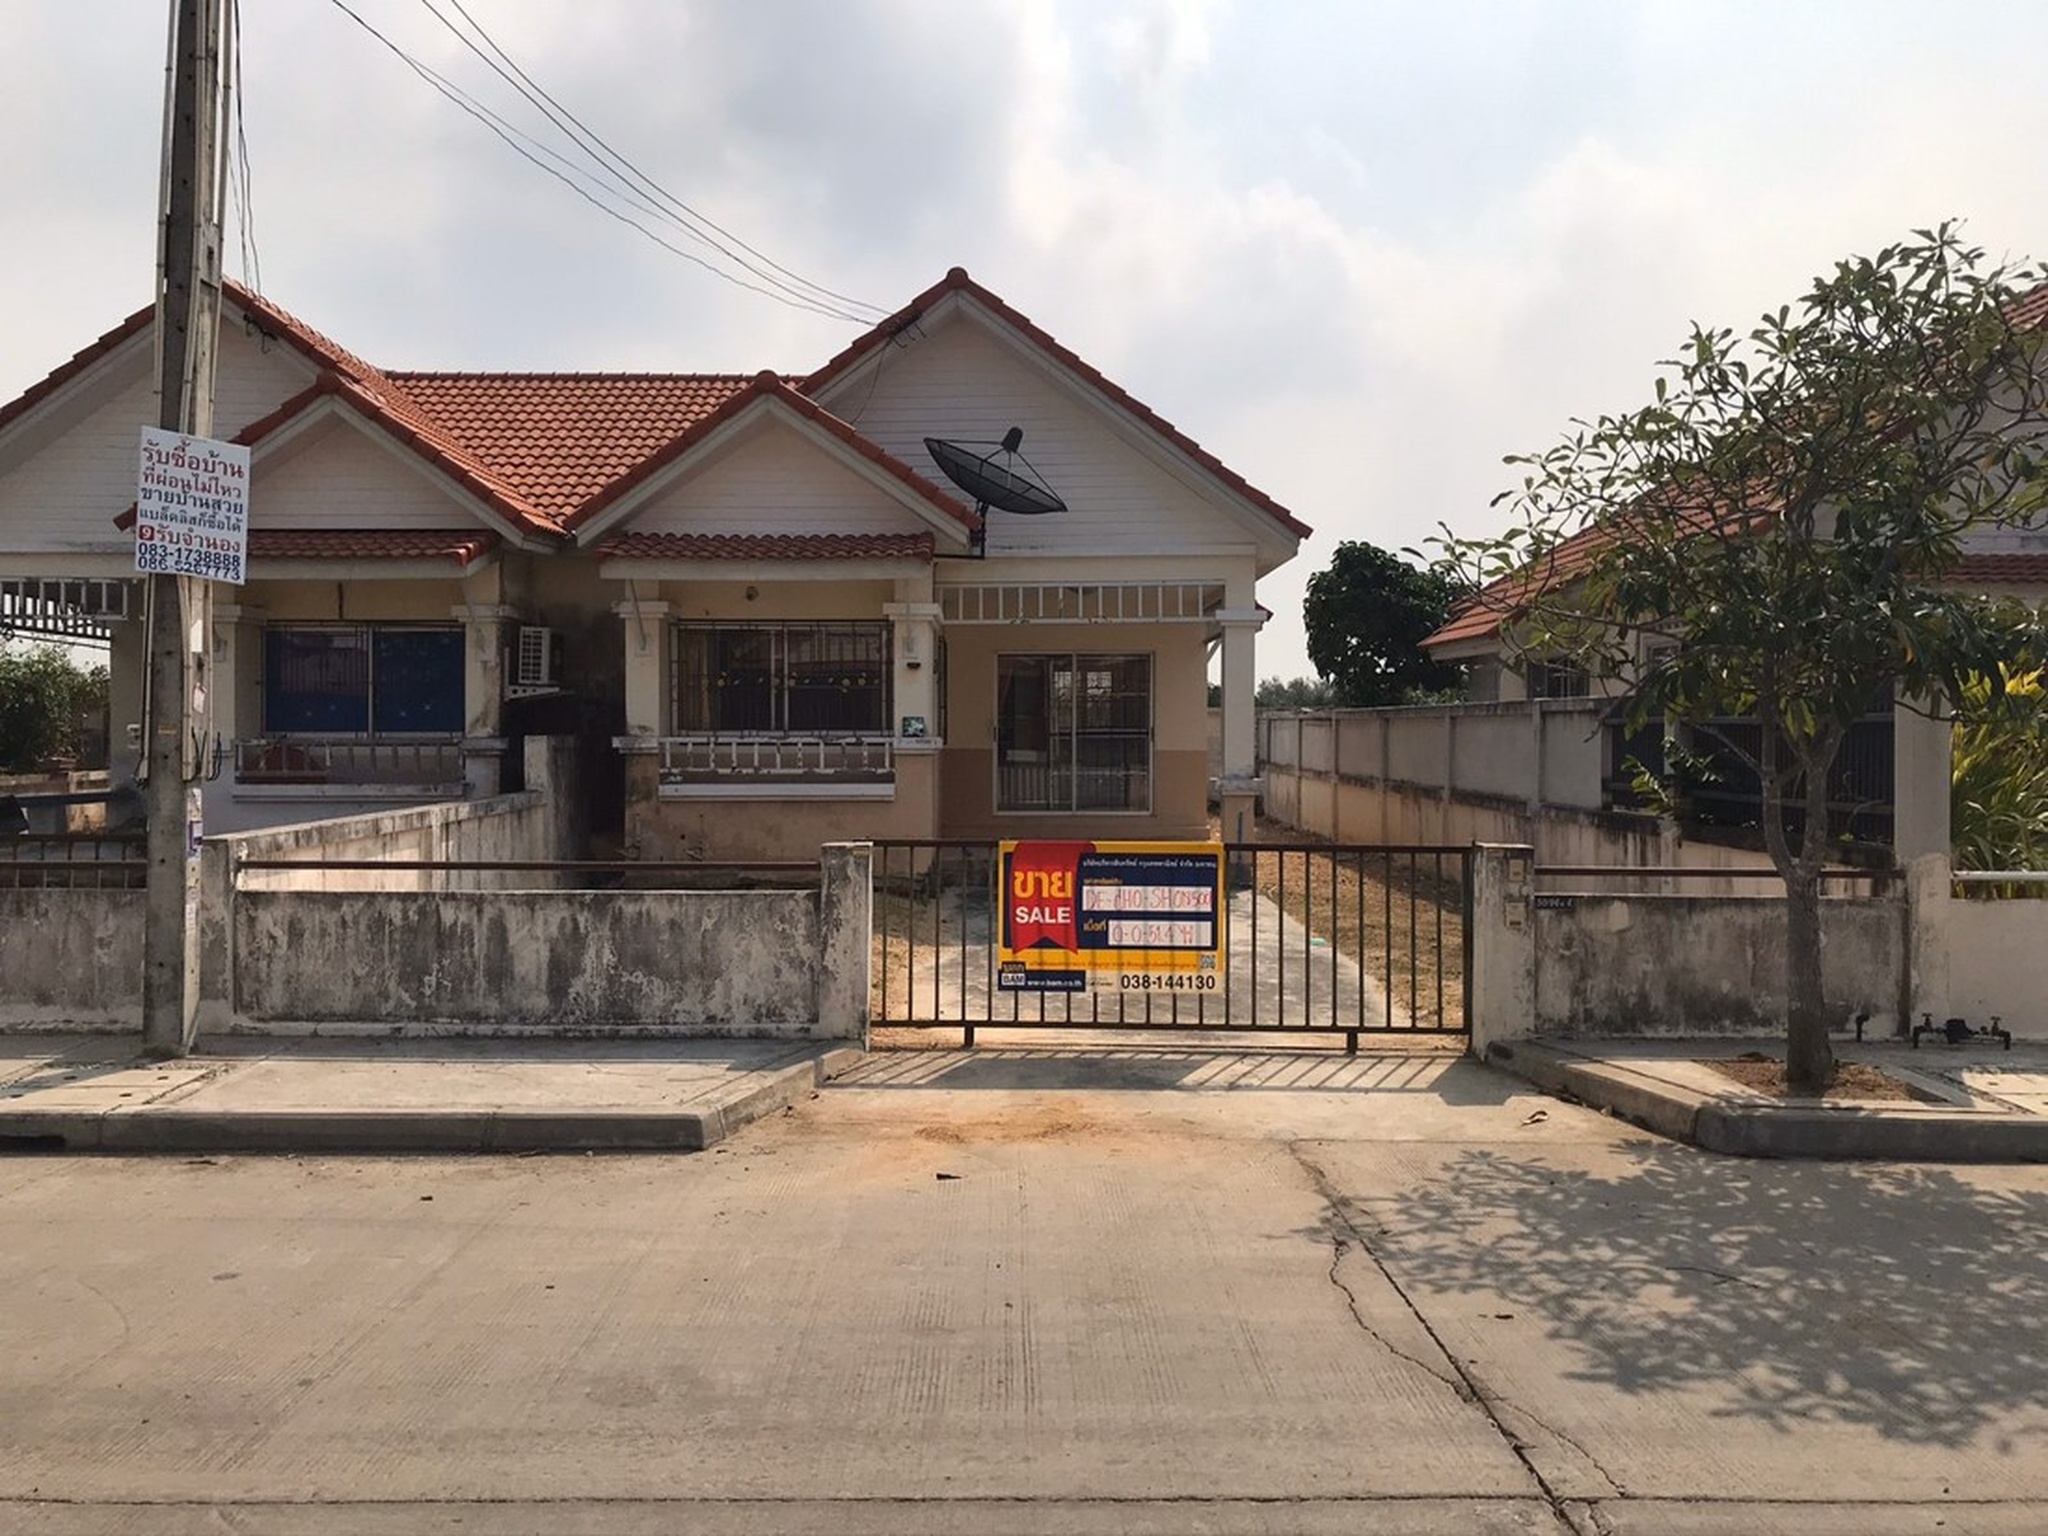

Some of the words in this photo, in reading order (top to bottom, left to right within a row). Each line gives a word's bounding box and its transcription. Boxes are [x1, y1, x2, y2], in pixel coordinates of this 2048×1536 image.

[143, 437, 244, 479] รับซื้อบ้าน
[142, 462, 242, 498] ที่ผ่อนไม่ไหว
[140, 487, 243, 515] ขายบ้านสวย
[156, 523, 241, 553] รับจำนอง
[138, 543, 241, 568] 083-1738888
[1013, 870, 1073, 898] ขาย
[1015, 907, 1071, 924] SALE
[1121, 975, 1216, 990] 038-144130
